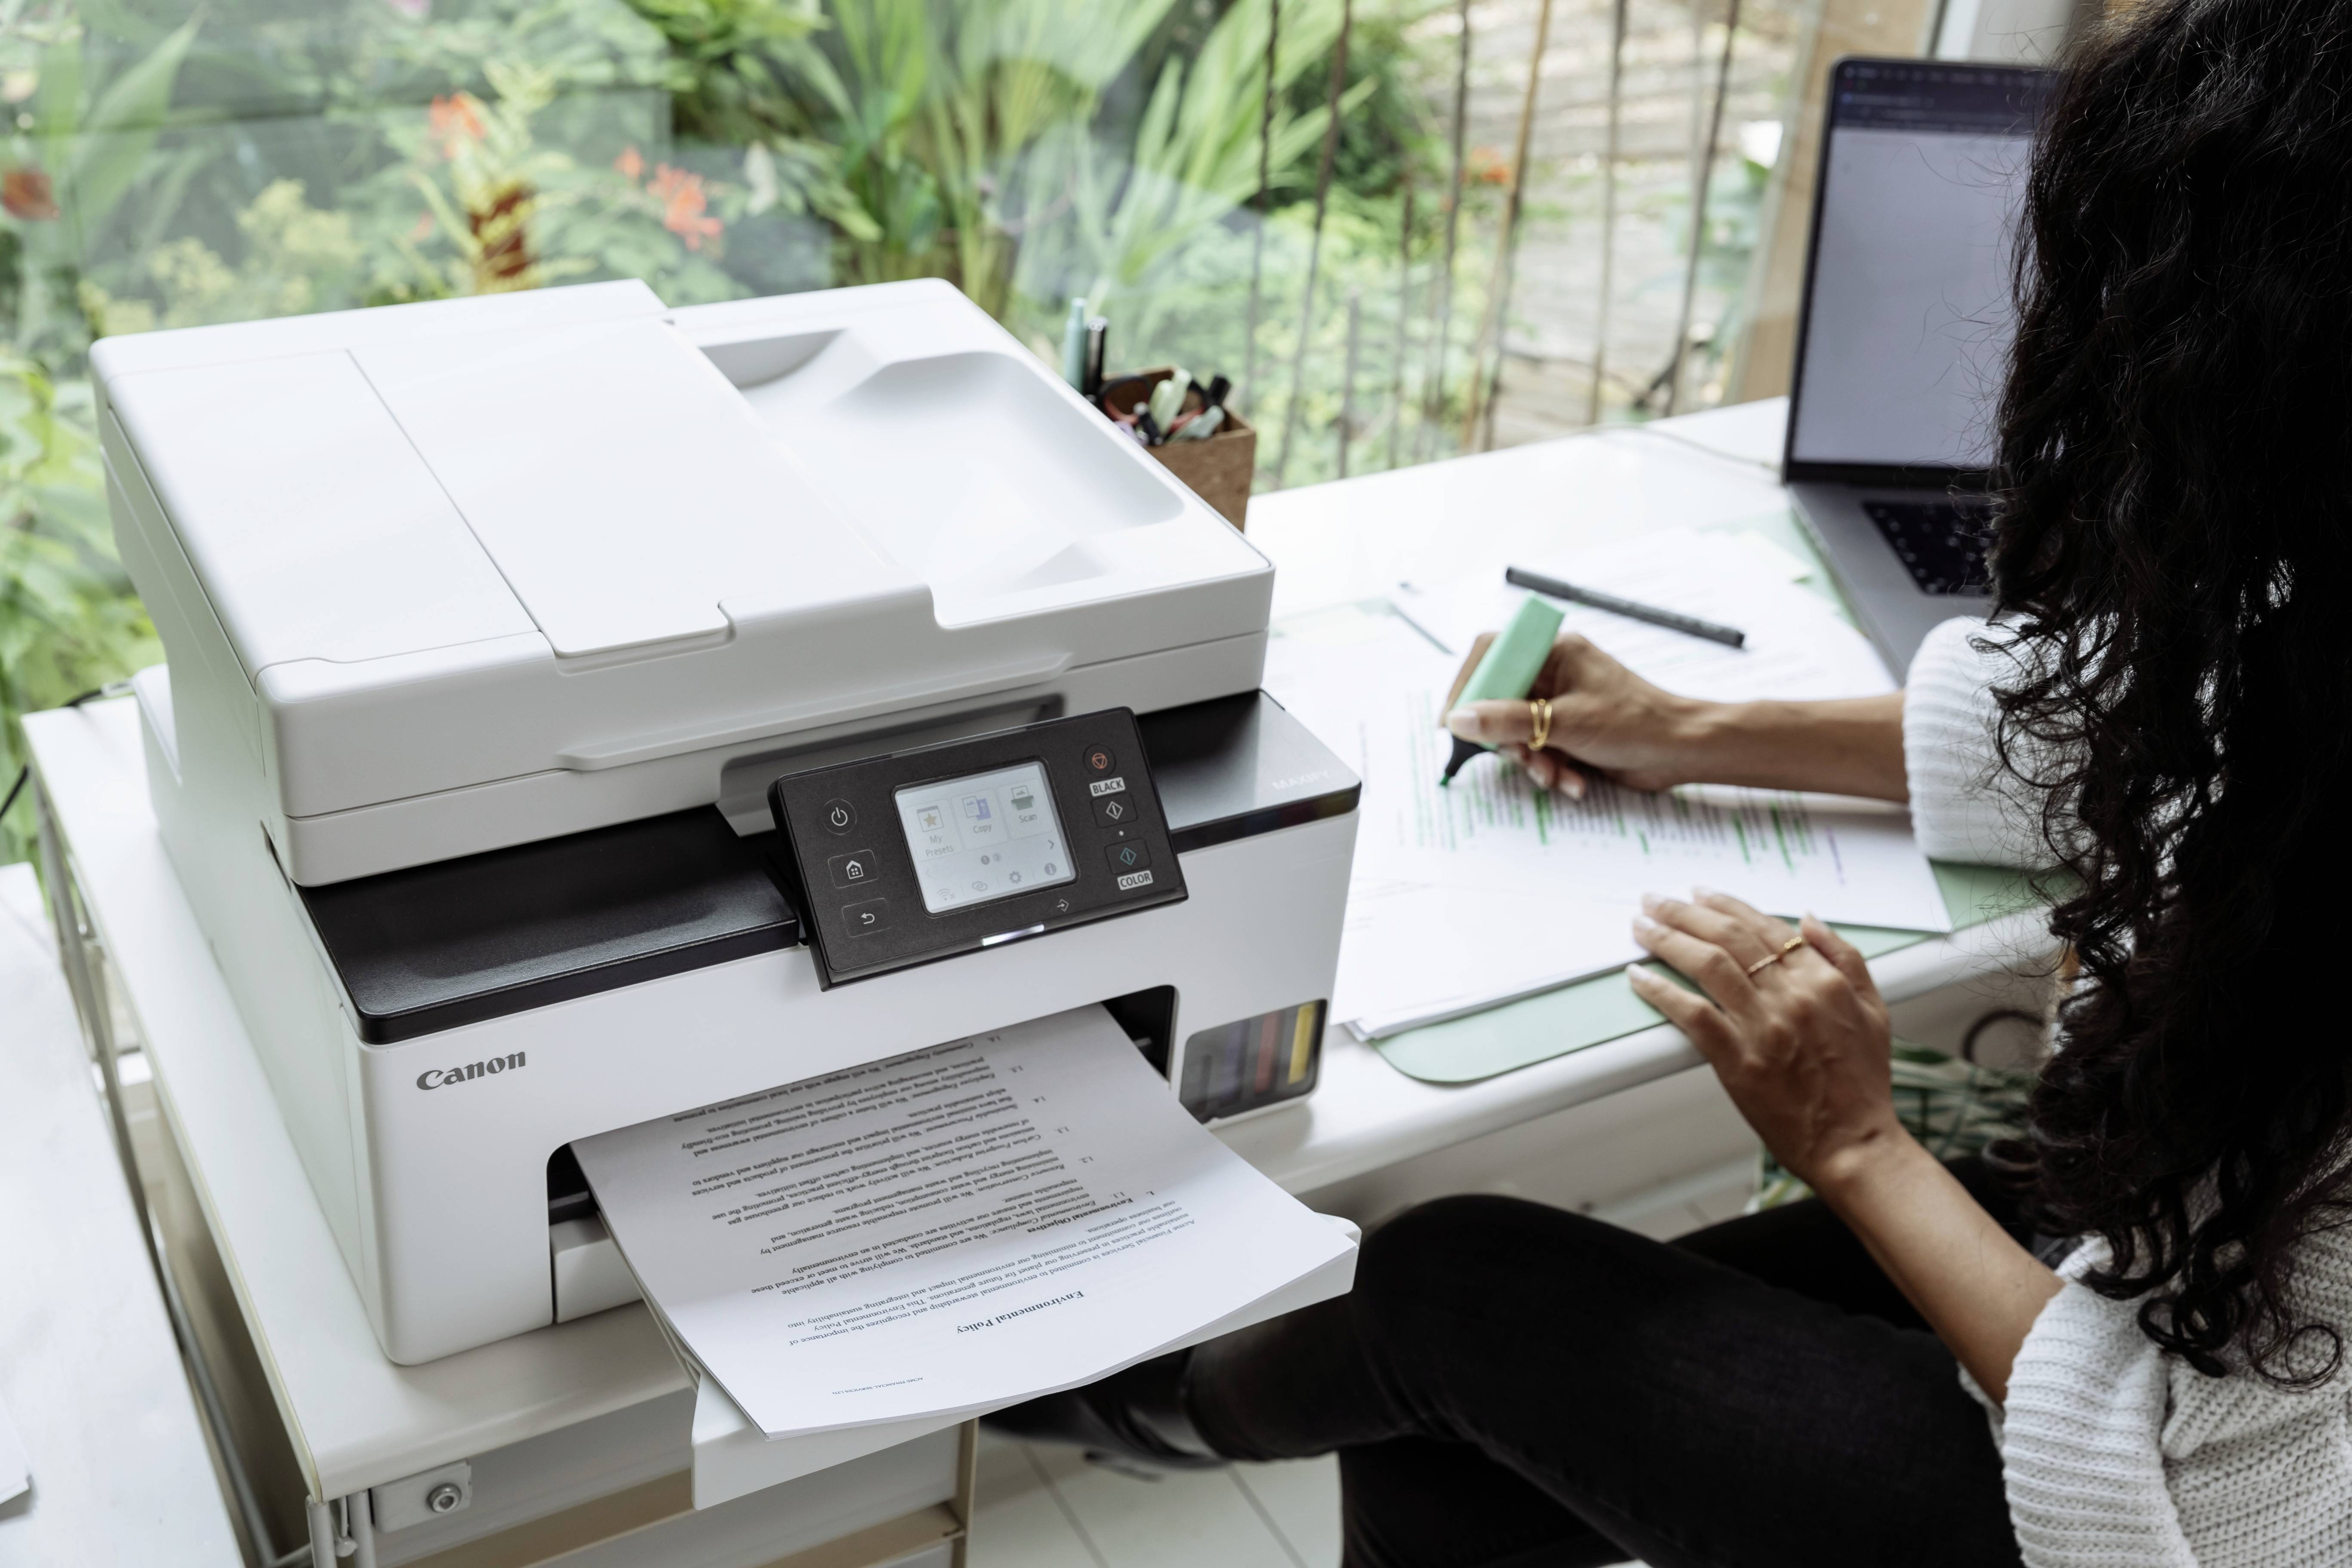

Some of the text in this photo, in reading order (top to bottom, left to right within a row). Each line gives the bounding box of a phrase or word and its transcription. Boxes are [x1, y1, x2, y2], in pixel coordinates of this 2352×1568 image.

[1092, 779, 1123, 794] BLACK
[1018, 814, 1038, 823] Scan
[972, 824, 992, 834] Copy
[930, 835, 942, 844] My
[925, 845, 954, 858] Presets
[1120, 873, 1151, 887] COLOR
[416, 1052, 525, 1090] Canon
[1000, 1149, 1054, 1167] implementing
[1015, 1156, 1059, 1172] minimising
[963, 1164, 1000, 1177] recycling
[989, 1169, 1015, 1180] energy
[924, 1179, 947, 1188] waste
[948, 1174, 963, 1183] and
[972, 1177, 988, 1185] and
[950, 1182, 972, 1191] water
[1034, 1179, 1078, 1194] responsible
[873, 1185, 923, 1204] management
[943, 1194, 959, 1203] will
[1034, 1186, 1084, 1203] requirements
[858, 1203, 895, 1216] reducing
[908, 1198, 942, 1212] promote
[1017, 1201, 1033, 1209] and
[1035, 1193, 1090, 1213] environmental
[1072, 1198, 1134, 1221] Environmental
[862, 1209, 907, 1225] responsible
[991, 1206, 1017, 1216] ensure
[1040, 1200, 1096, 1222] Environmental
[1128, 1206, 1163, 1219] business
[1152, 1207, 1182, 1220] outlines
[835, 1214, 858, 1223] waste
[938, 1217, 975, 1231] activities
[1027, 1217, 1071, 1233] Objectives
[1085, 1217, 1127, 1233] operations.
[1147, 1213, 1189, 1231] sustainable
[1173, 1219, 1194, 1230] Acme
[826, 1222, 861, 1235] resource
[949, 1230, 965, 1238] and
[1087, 1224, 1136, 1243] commitment
[1111, 1228, 1146, 1243] practices
[770, 1234, 786, 1243] and
[772, 1233, 825, 1252] management
[882, 1233, 923, 1249] conducted
[1135, 1229, 1173, 1246] Financial
[874, 1252, 891, 1260] will
[914, 1241, 958, 1258] committed
[1031, 1243, 1077, 1259] minimising
[1058, 1243, 1101, 1261] preserving
[1101, 1243, 1135, 1256] Services
[792, 1252, 859, 1274] environmentally
[849, 1256, 873, 1266] strive
[858, 1257, 903, 1273] complying
[1017, 1262, 1043, 1274] planet
[1048, 1258, 1091, 1275] committed
[817, 1267, 838, 1276] meet
[839, 1271, 858, 1279] with
[957, 1262, 1015, 1283] environmental
[775, 1276, 805, 1289] exceed
[781, 1280, 825, 1294] applicable
[928, 1280, 957, 1292] impact
[978, 1276, 1003, 1286] future
[980, 1274, 1038, 1296] environmental
[751, 1285, 774, 1293] these
[910, 1289, 927, 1297] and
[927, 1282, 976, 1300] generations.
[863, 1293, 910, 1309] integrating
[906, 1299, 927, 1307] This
[929, 1292, 979, 1310] stewardship
[808, 1307, 863, 1324] sustainability
[842, 1305, 906, 1325] Environmental
[912, 1308, 928, 1316] and
[957, 1291, 1084, 1333] Environmental Policy
[815, 1321, 842, 1331] Policy
[866, 1312, 911, 1327] recognizes
[800, 1329, 849, 1342] importance
